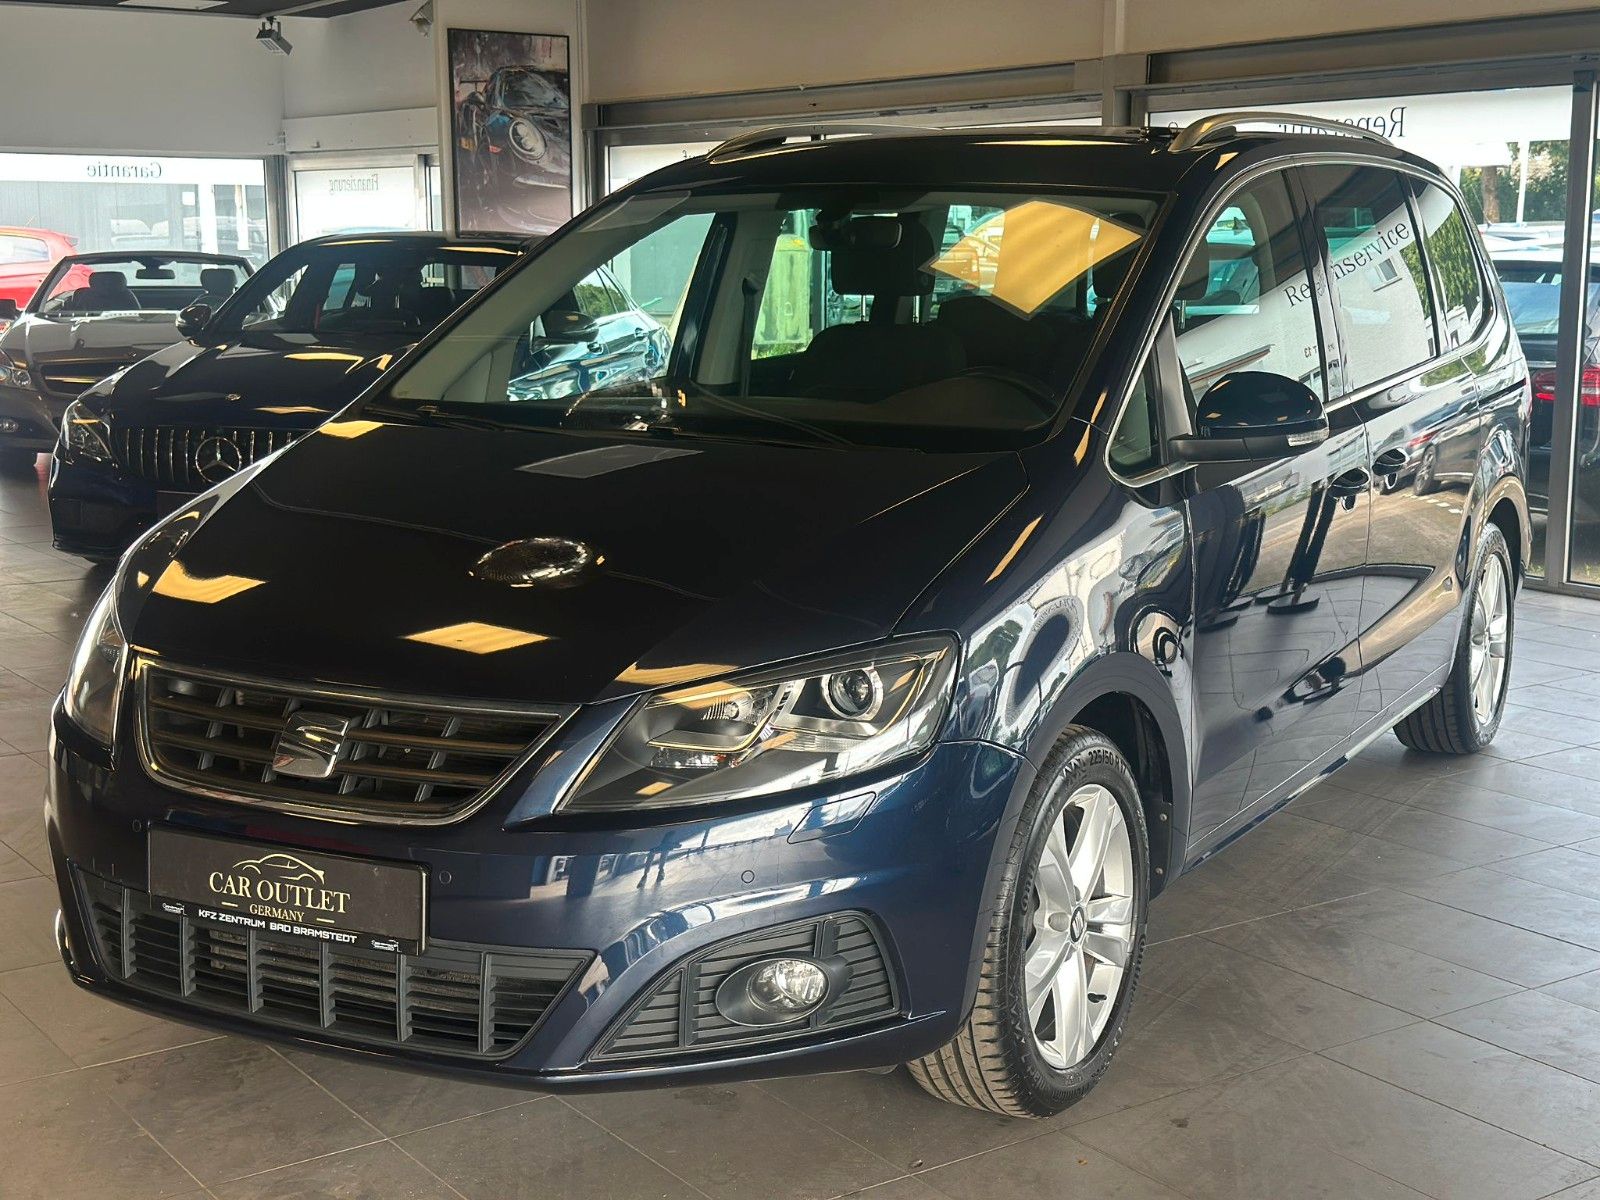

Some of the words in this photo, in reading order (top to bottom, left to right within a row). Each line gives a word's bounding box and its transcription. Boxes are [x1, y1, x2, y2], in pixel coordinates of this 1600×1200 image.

[1088, 749, 1113, 766] 225/50
[209, 871, 252, 898] CAR
[256, 879, 351, 914] OUTLET
[198, 908, 217, 920] KFZ
[218, 912, 266, 929] ZENTRUM
[269, 922, 292, 933] BAD
[293, 926, 358, 944] BRAMSTEDT
[249, 903, 305, 922] GERMANY
